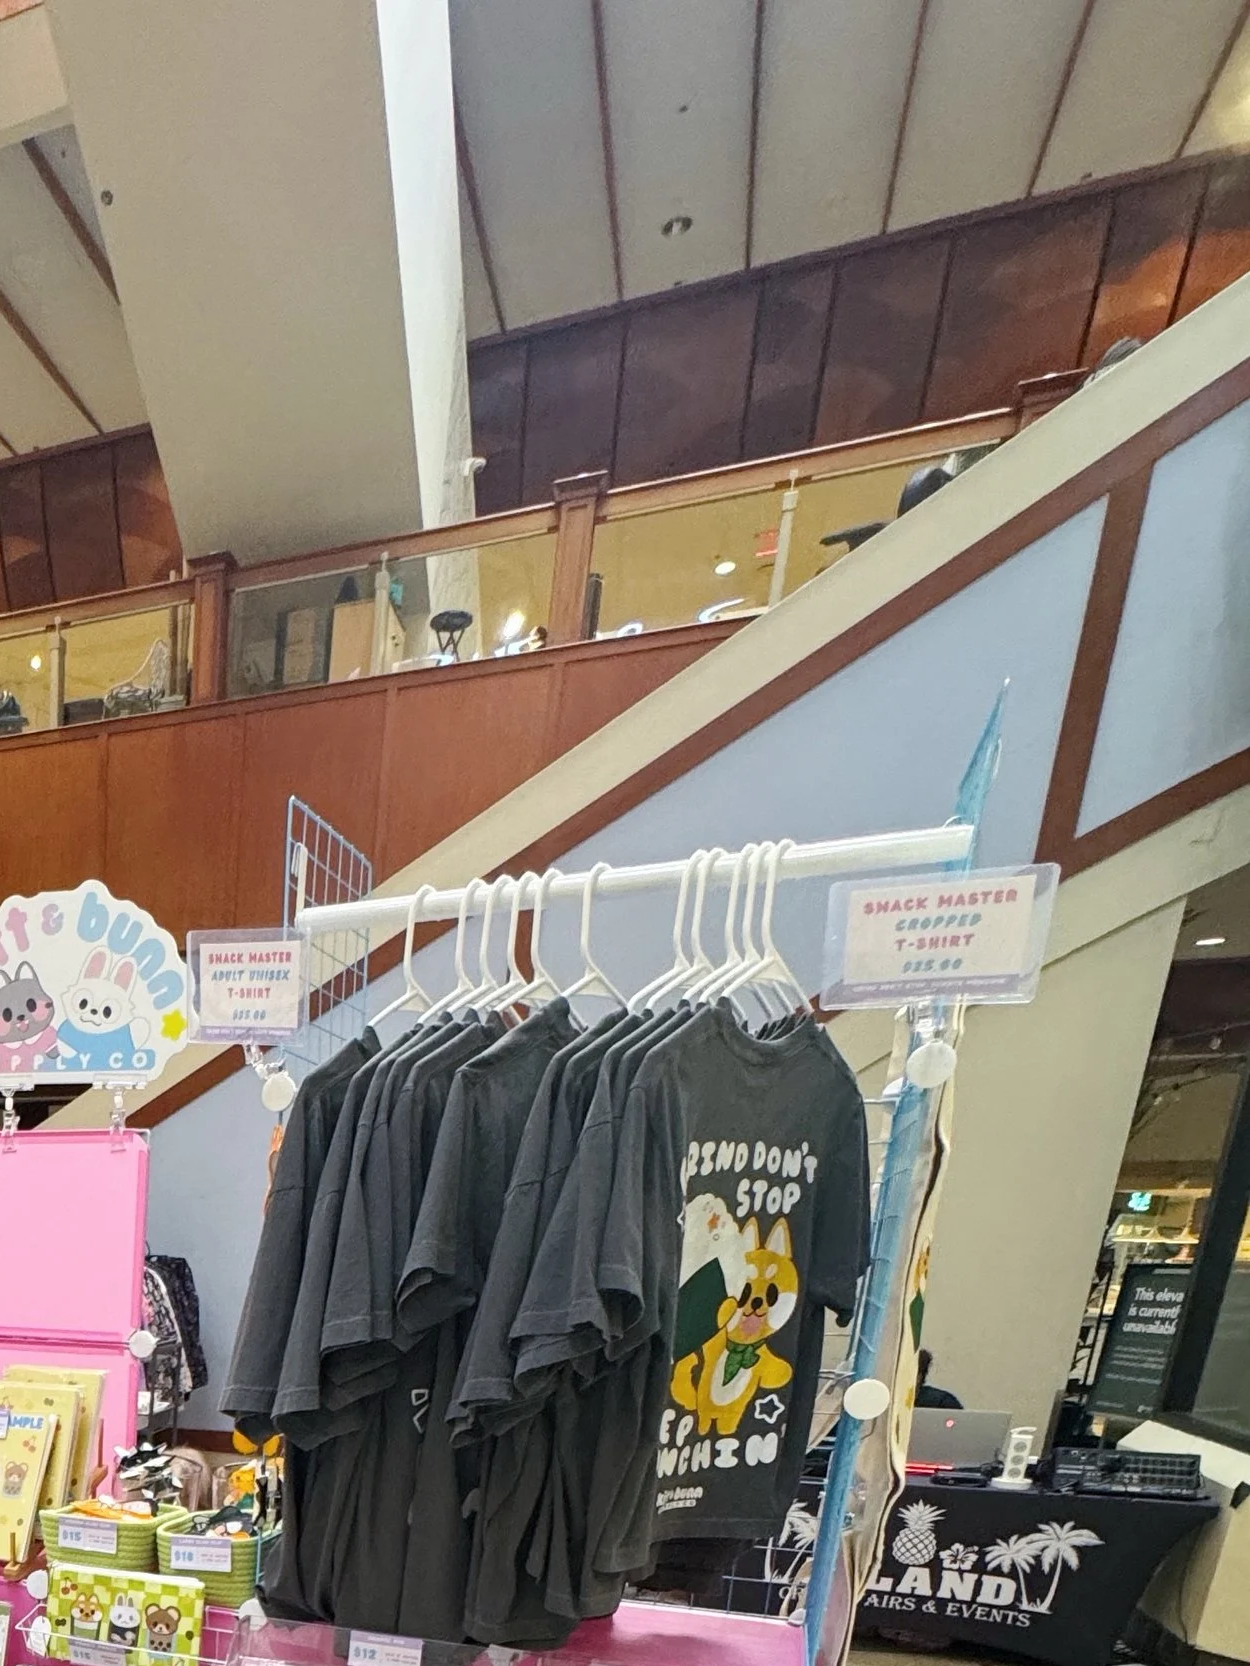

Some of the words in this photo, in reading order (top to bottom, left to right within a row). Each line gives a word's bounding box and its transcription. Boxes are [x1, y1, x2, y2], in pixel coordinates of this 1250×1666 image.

[863, 896, 928, 915] SNACK
[938, 889, 1018, 907] MASTER
[895, 913, 982, 931] CROPPED
[41, 903, 64, 935] &
[77, 891, 185, 1011] bunn
[894, 933, 975, 951] T-SHIRT
[208, 952, 244, 964] SNACK
[249, 951, 292, 963] MASTER
[211, 969, 244, 981] ADULT
[247, 970, 290, 981] UNISEX
[227, 987, 271, 998] T-SHIRT
[108, 1051, 146, 1069] CO
[681, 1140, 749, 1192] RIND
[753, 1140, 818, 1184] DON'T
[736, 1178, 801, 1218] STOP
[1135, 1287, 1155, 1301] This
[1155, 1287, 1185, 1303] eleva
[1128, 1303, 1137, 1316] is
[1138, 1304, 1182, 1319] currentl
[1122, 1319, 1179, 1335] unavailabl
[659, 1408, 694, 1448] EP
[865, 1563, 1017, 1607] LAND
[864, 1593, 916, 1611] AIRS
[922, 1600, 937, 1614] &
[946, 1603, 1031, 1627] EVENTS
[354, 1646, 377, 1660] $12
